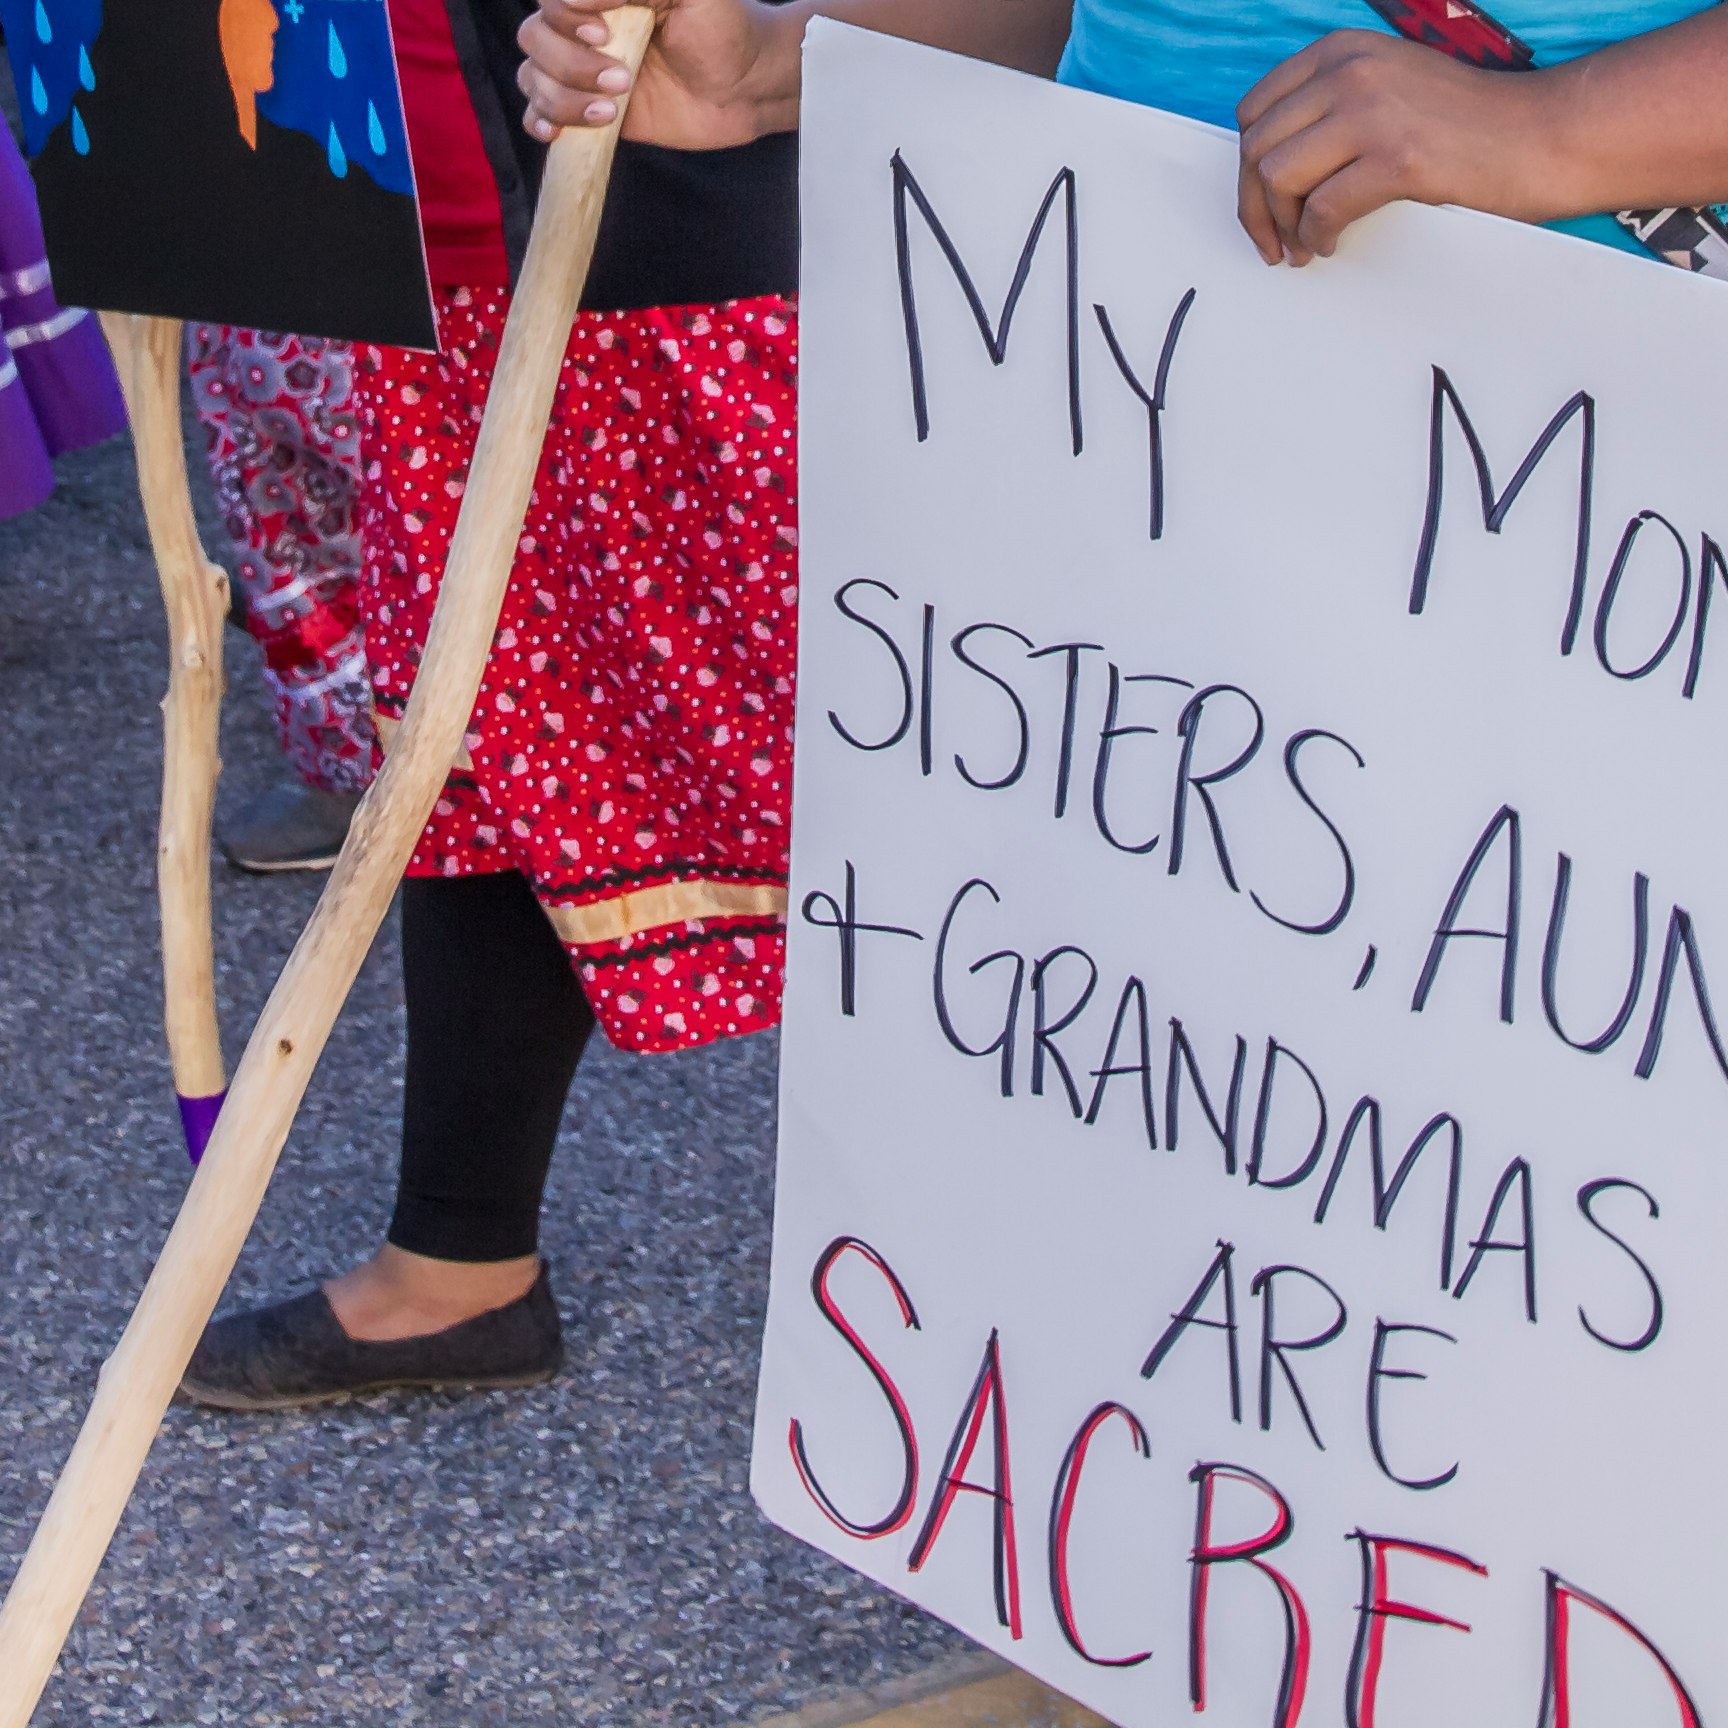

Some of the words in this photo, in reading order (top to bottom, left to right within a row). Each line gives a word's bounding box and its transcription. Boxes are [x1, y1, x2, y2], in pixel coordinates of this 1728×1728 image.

[827, 577, 1378, 992] SISTERS,
[932, 878, 1664, 1353] GRANDMAS
[788, 1235, 1704, 1728] SACRED
[1139, 1237, 1460, 1491] ARE
